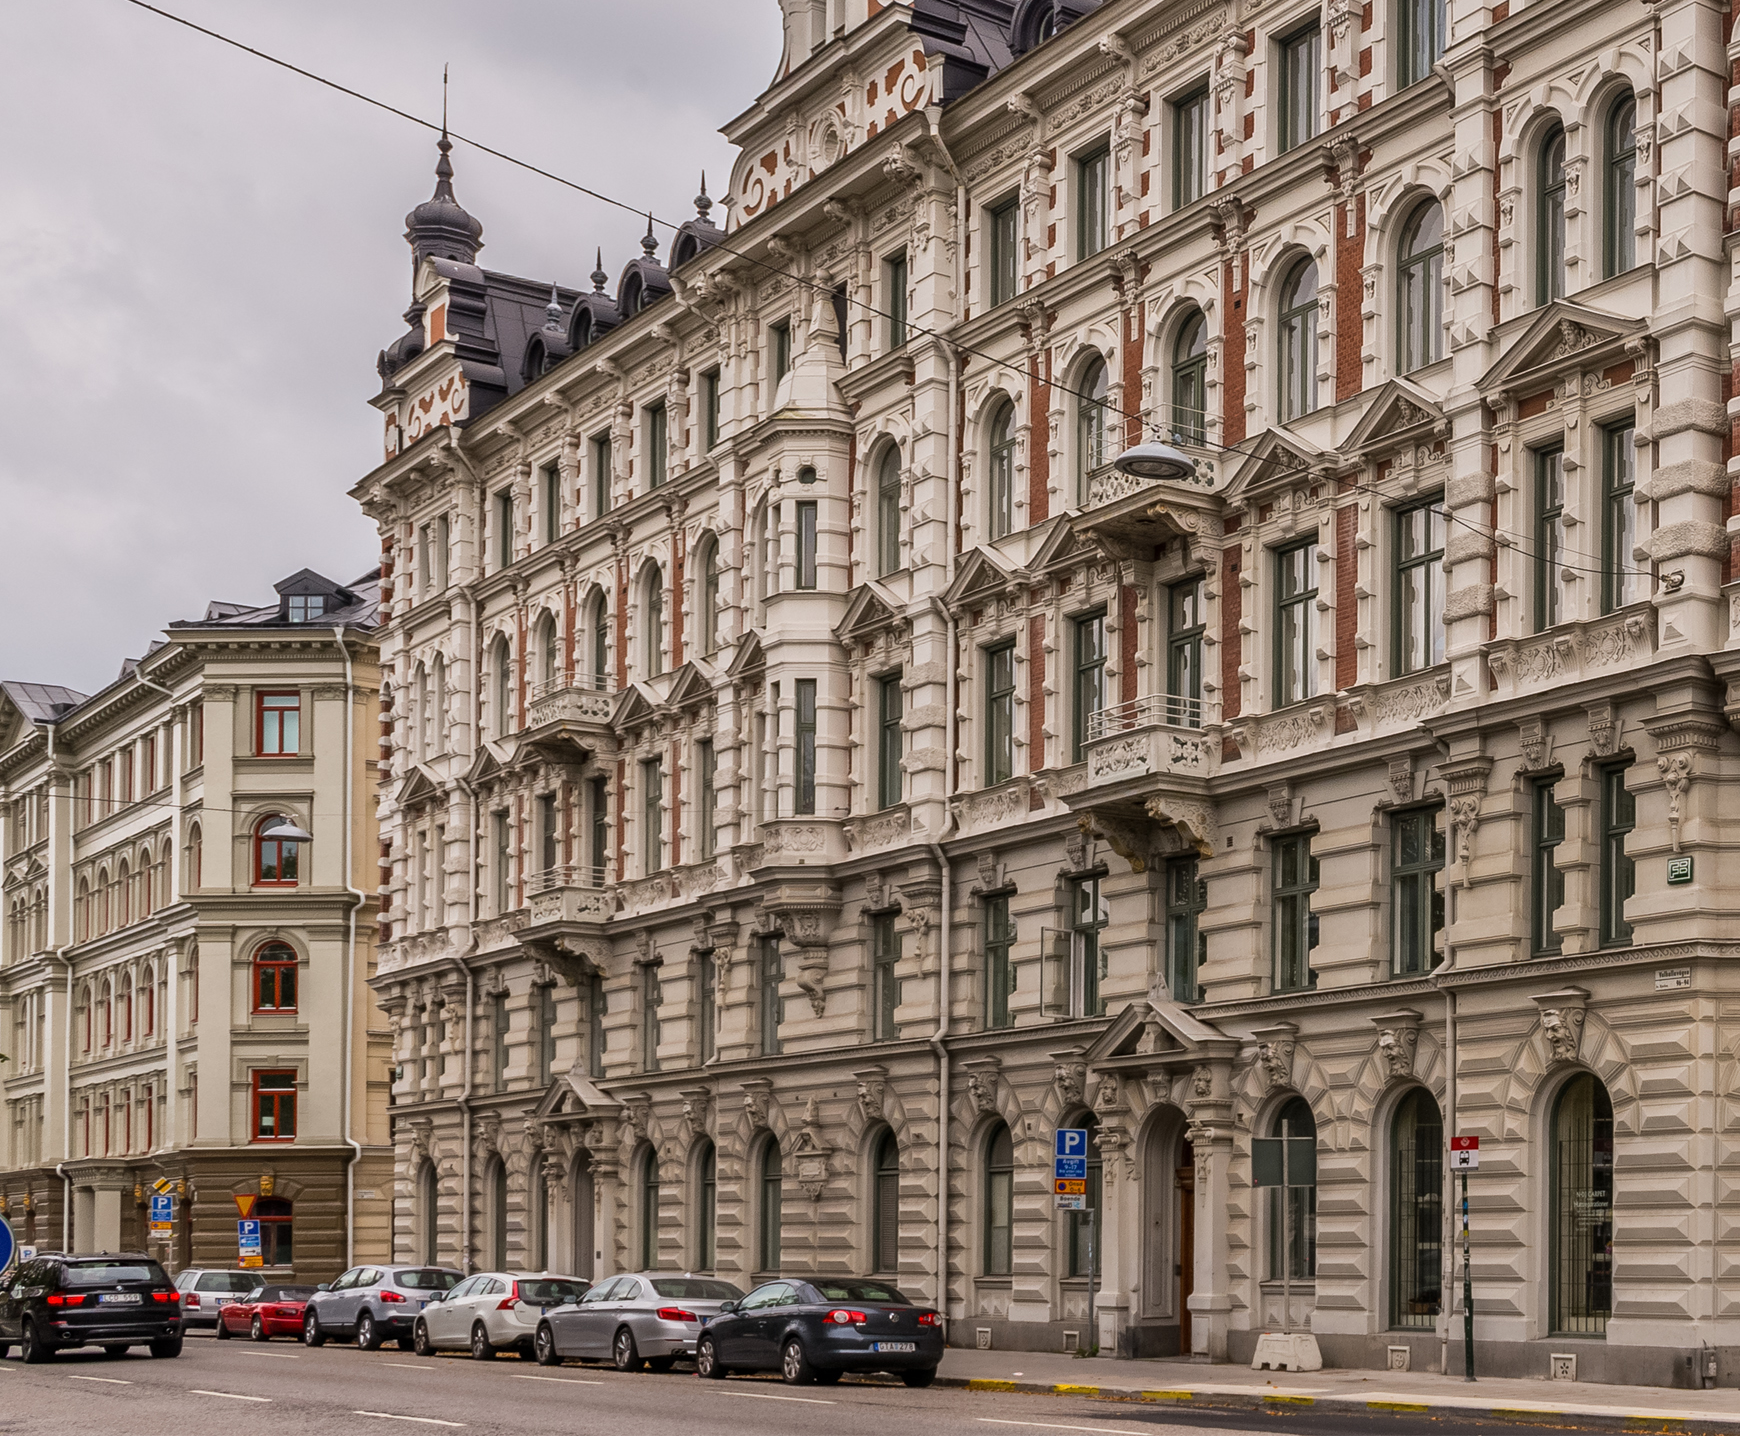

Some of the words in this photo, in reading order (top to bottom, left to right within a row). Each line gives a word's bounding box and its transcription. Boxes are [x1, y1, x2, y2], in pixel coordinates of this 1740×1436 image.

[1065, 1132, 1080, 1154] P
[158, 1198, 168, 1209] P
[244, 1222, 254, 1234] P
